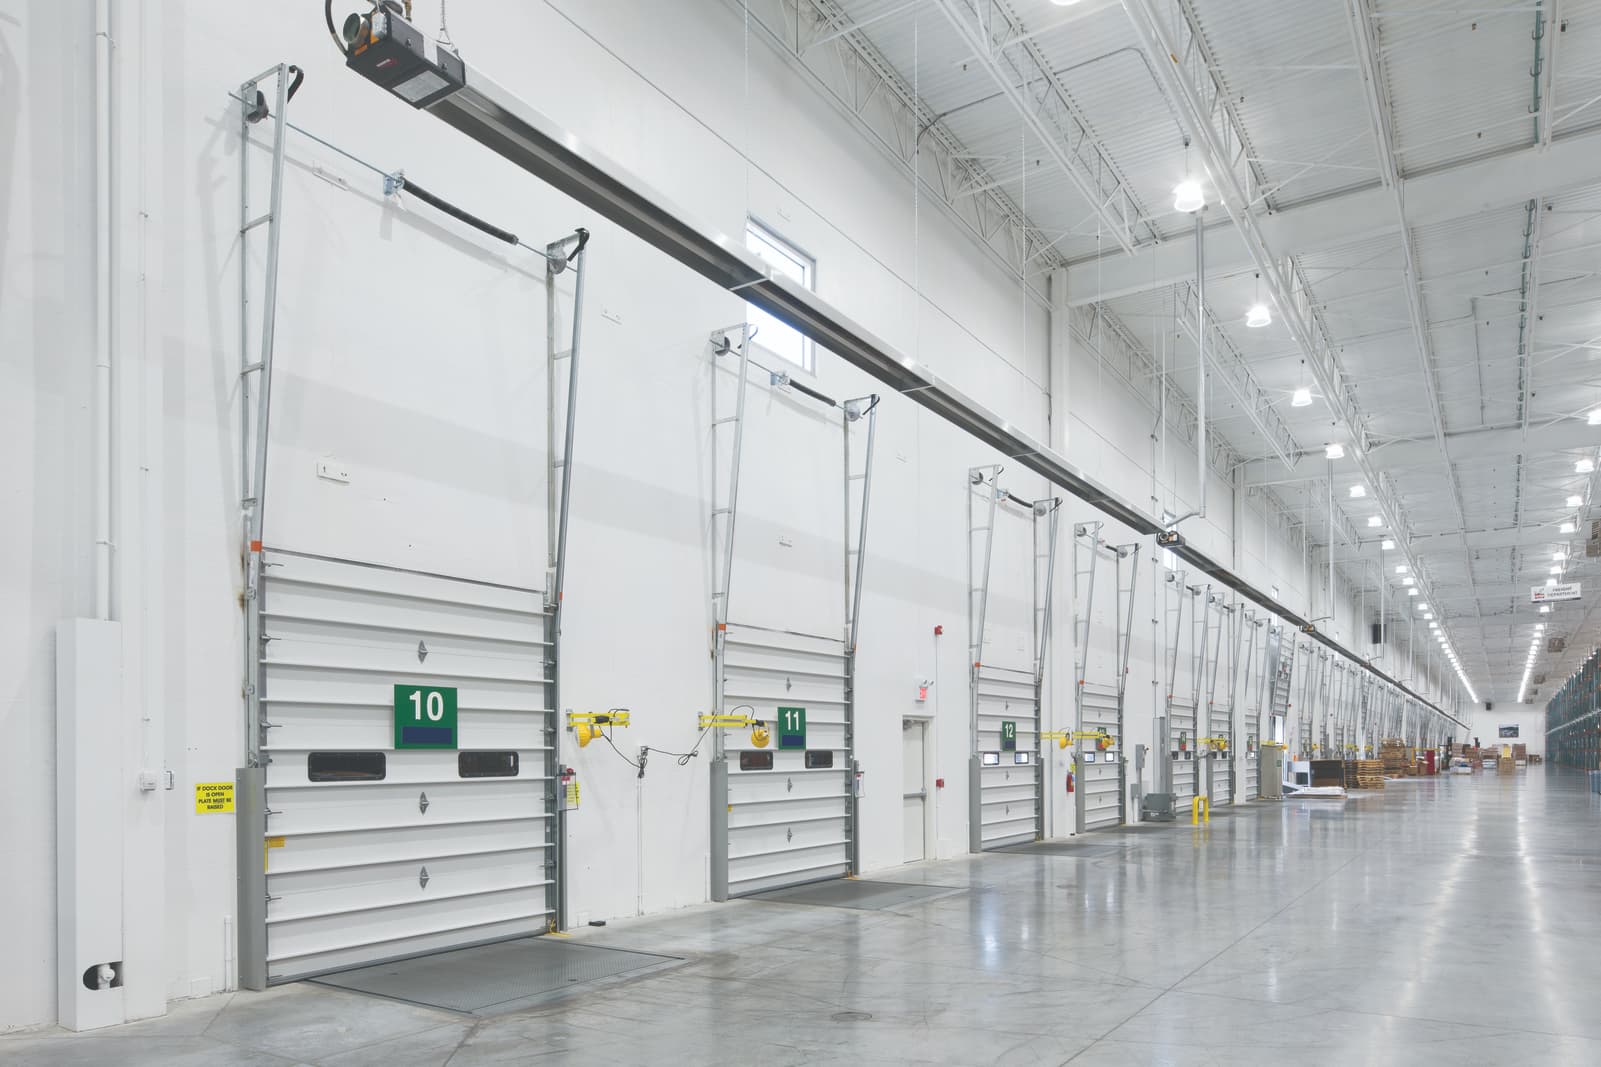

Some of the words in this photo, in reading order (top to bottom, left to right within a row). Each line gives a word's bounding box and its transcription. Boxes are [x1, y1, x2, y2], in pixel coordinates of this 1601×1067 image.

[409, 690, 444, 721] 10
[785, 710, 799, 731] 11
[1005, 723, 1014, 739] 12
